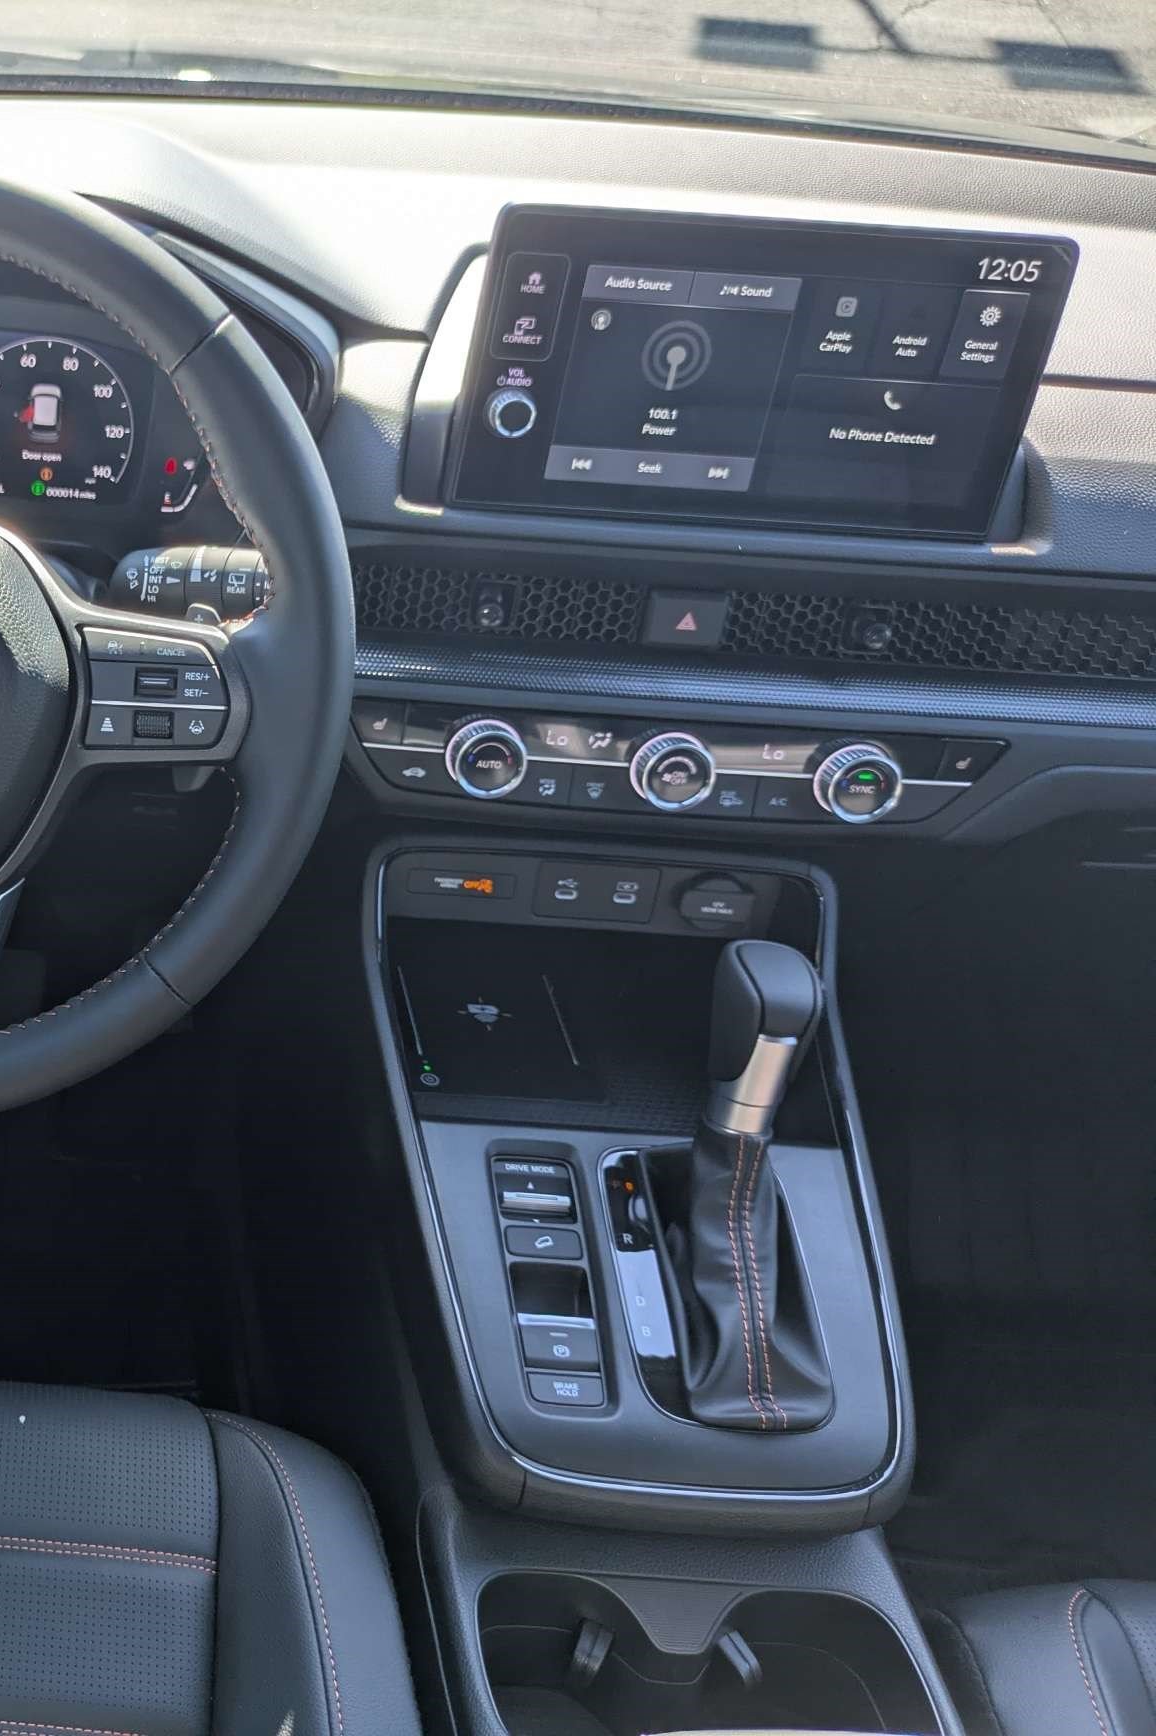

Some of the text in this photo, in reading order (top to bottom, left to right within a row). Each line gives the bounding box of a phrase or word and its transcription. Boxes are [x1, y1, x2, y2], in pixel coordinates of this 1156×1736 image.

[977, 257, 1042, 283] 12:05
[520, 284, 545, 294] HOME
[604, 276, 672, 292] Audio Source
[740, 285, 772, 298] Sound
[502, 335, 542, 345] CONNECT
[825, 330, 852, 343] Apple
[892, 335, 927, 347] Android
[819, 342, 852, 354] CarPlay
[964, 340, 998, 351] General
[895, 347, 917, 357] Auto
[960, 351, 995, 364] Settings
[20, 354, 37, 368] 60
[62, 357, 80, 371] 80
[508, 368, 525, 377] VOL
[506, 377, 533, 387] AUDIO
[93, 385, 113, 398] 100
[647, 407, 678, 420] 100.1
[105, 425, 124, 439] 120
[642, 424, 677, 437] Power
[829, 427, 936, 445] No Phone Detected
[22, 449, 62, 463] Door open
[92, 465, 111, 478] 140
[637, 463, 663, 474] Seek
[46, 487, 79, 499] 000014
[149, 566, 165, 574] OFF
[148, 576, 163, 584] INT
[147, 585, 159, 594] LO
[226, 586, 245, 594] REAR
[156, 648, 186, 656] CANCEL
[475, 759, 503, 770] AUTO
[848, 783, 876, 794] SYNC
[504, 1163, 556, 1175] DRIVE MODE
[622, 1232, 634, 1245] R
[635, 1295, 646, 1307] D
[553, 1381, 580, 1390] BRAKE
[556, 1389, 579, 1397] HOLD
